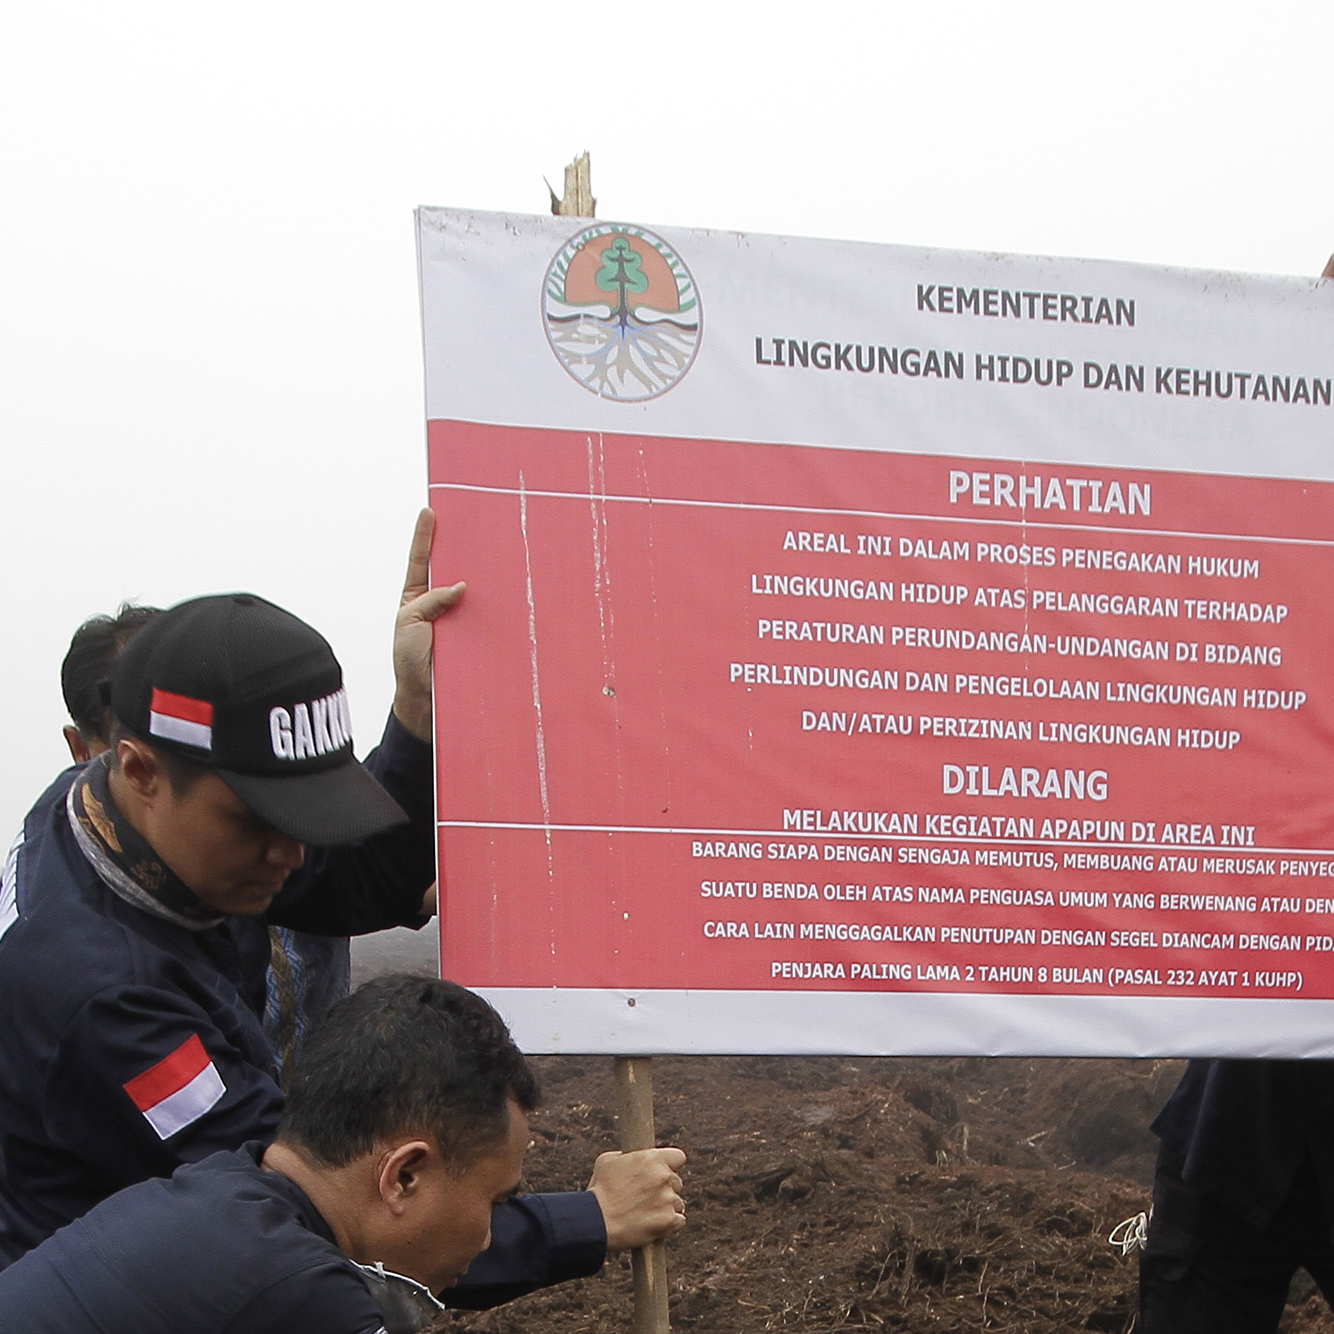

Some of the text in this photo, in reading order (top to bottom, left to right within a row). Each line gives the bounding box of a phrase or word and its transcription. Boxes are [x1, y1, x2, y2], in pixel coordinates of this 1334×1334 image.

[916, 283, 1136, 326] KEMENTERIAN
[755, 337, 1332, 406] LINGKUNGAN HIDUP DAN KEHUTANAN
[949, 470, 1151, 516] PERHATIAN
[783, 530, 1259, 579] AREAL INI DALAM PROSES PENEGAKAN HUKUM
[751, 574, 1288, 624] LINGKUNGAN HIDUP ATAS PELANGGARAN TERHADAP
[758, 619, 1281, 666] PERATURAN PERUNDANGAN-UNDANGAN DI BIDANG
[730, 663, 1307, 710] PERLINDUNGAN DAN PENGELOLAAN LINGKUNGAN HIDUP
[802, 710, 1241, 750] DAN/ATAU PERIZINAN LINGKUNGAN HIDUP
[943, 764, 1108, 801] DILARANG
[782, 808, 1257, 846] MELAKUKAN KEGIATAN APAPUN DI AREA INI
[692, 841, 763, 859] BARANG
[767, 843, 819, 860] SIAPA
[824, 845, 893, 863] DENGAN
[897, 847, 971, 865] SENGAJA
[975, 850, 1059, 872] MEMUTUS,
[1063, 853, 1154, 871] MEMBUANG
[1157, 856, 1198, 873] ATAU
[1202, 857, 1276, 875] MERUSAK
[700, 881, 757, 898] SUATU
[762, 882, 819, 900] BENDA
[823, 884, 867, 901] OLEH
[871, 885, 914, 903] ATAS
[918, 887, 966, 904] NAMA
[969, 888, 1055, 906] PENGUASA
[1059, 891, 1108, 908] UMUM
[1112, 892, 1155, 909] YANG
[1160, 894, 1257, 912] BERWENANG
[1260, 897, 1301, 913] ATAU
[703, 921, 750, 938] CARA
[754, 922, 795, 939] LAIN
[800, 923, 936, 942] MENGGAGALKAN
[940, 927, 1036, 945] PENUTUPAN
[1041, 929, 1106, 946] DENGAN
[1110, 930, 1159, 947] SEGEL
[1162, 932, 1234, 949] DIANCAM
[1239, 934, 1301, 951] DENGAN
[771, 962, 1303, 991] PENJARA PALING LAMA 2 TAHUN 8 BULAN (PASAL 232 AYAT 1 KUHP)
